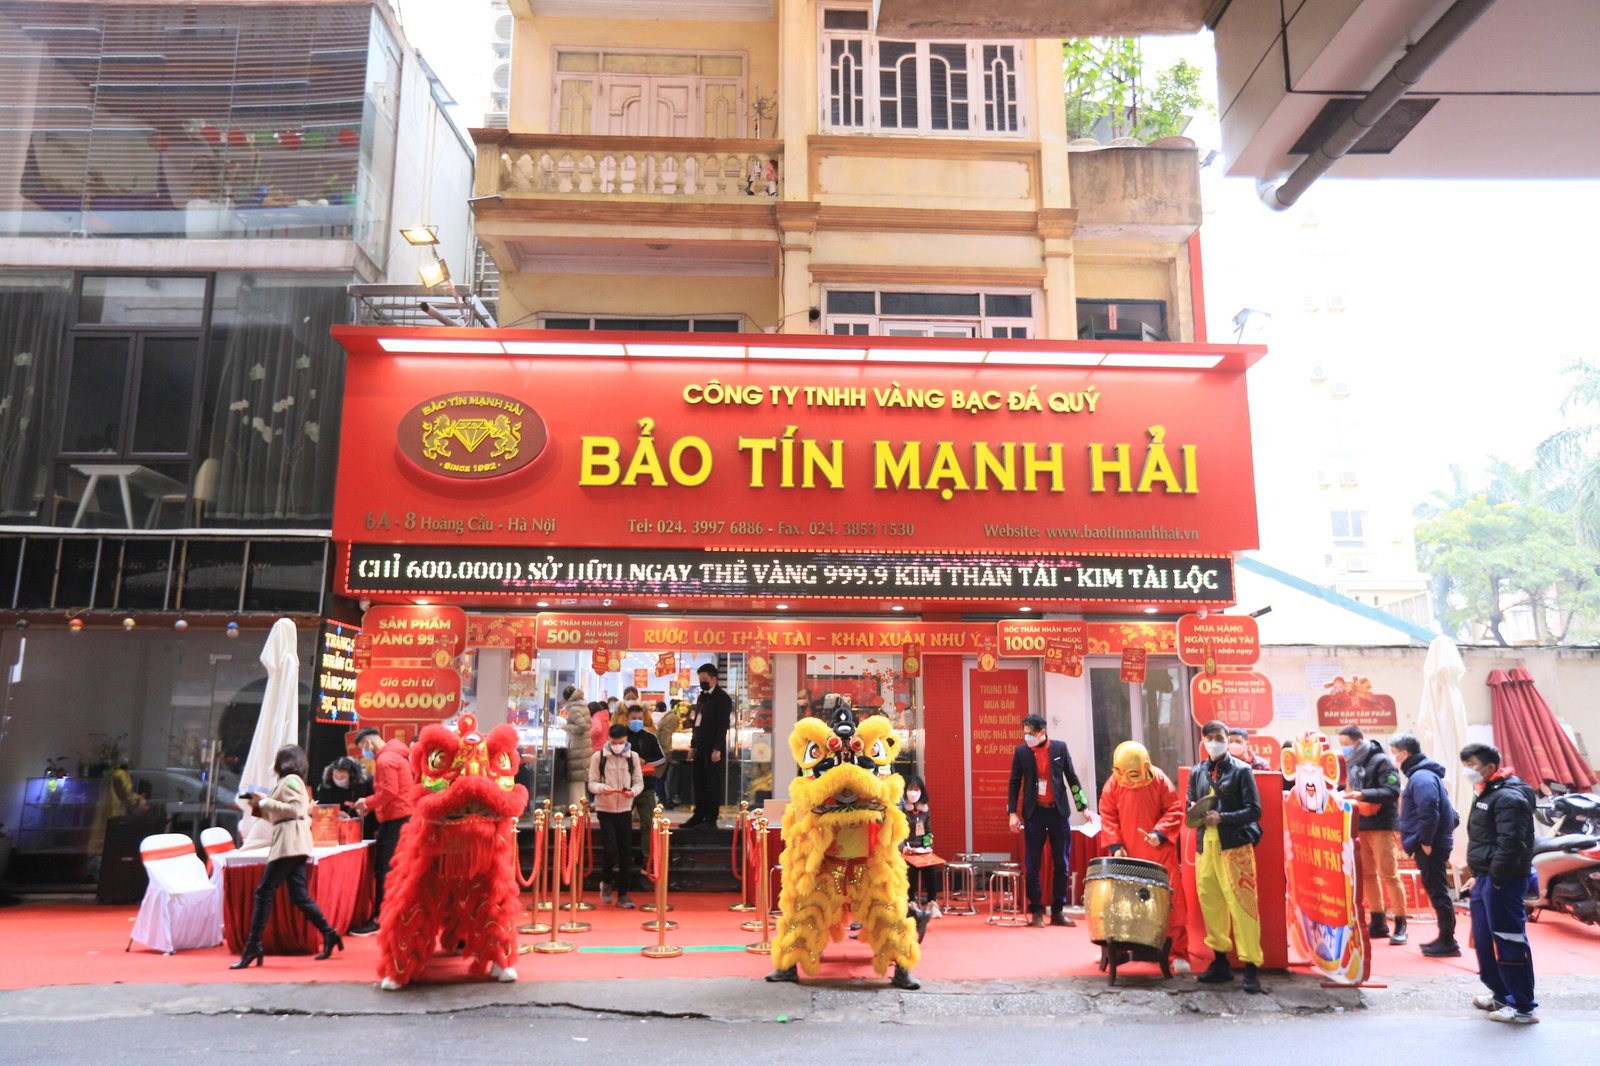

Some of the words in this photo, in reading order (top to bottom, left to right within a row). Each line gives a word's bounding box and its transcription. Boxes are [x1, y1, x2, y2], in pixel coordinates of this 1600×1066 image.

[683, 379, 764, 405] CÔNG
[769, 386, 799, 406] TY
[804, 386, 867, 407] TNHH
[873, 381, 946, 409] VÀNG
[951, 390, 1002, 414] BẠC
[1007, 385, 1043, 412] ĐÁ
[1048, 385, 1100, 413] QUÝ
[578, 417, 713, 487] BẢO
[738, 425, 845, 488] TÍN
[873, 440, 1065, 500] MẠNH
[1089, 425, 1199, 494] HẢI
[365, 511, 391, 531] 6A
[404, 512, 417, 530] 8
[420, 516, 465, 534] Hoàng
[467, 514, 494, 532] Cầu
[507, 517, 528, 532] Hà
[532, 518, 556, 534] Nội
[628, 518, 653, 533] Tel:
[657, 519, 687, 534] 024.
[692, 520, 726, 534] 3997
[730, 521, 764, 535] 6886
[808, 522, 838, 536] 024.
[844, 523, 877, 537] 3853
[882, 523, 915, 537] 1530
[984, 523, 1041, 539] Website:
[1046, 524, 1199, 541] www.baotinmanhhai.vn
[527, 555, 563, 580] SỞ
[629, 563, 693, 582] NGAY
[752, 559, 817, 584] VÀNG
[823, 565, 888, 585] 999.9
[895, 566, 942, 586] KIM
[1018, 563, 1057, 587] TÀI
[1077, 568, 1123, 588] KIM
[1128, 564, 1168, 590] TÀI
[1173, 564, 1218, 593] LỘC
[379, 615, 407, 629] SẢN
[410, 615, 451, 629] PHẨM
[1193, 625, 1215, 633] MUA
[1216, 623, 1243, 632] HÀNG
[371, 631, 414, 645] VÀNG
[546, 629, 580, 644] 500
[644, 627, 688, 645] RƯỚC
[693, 628, 725, 647] LỘC
[783, 629, 812, 646] TÀI
[831, 632, 874, 646] KHAI
[879, 630, 926, 647] XUÂN
[930, 632, 966, 647] NHƯ
[970, 631, 981, 647] Ý
[1004, 636, 1046, 651] 1000
[1184, 634, 1210, 645] NGÀY
[1239, 635, 1254, 644] TÀI
[1046, 648, 1063, 659] 05
[979, 685, 1002, 694] TRUNG
[1003, 683, 1019, 694] TÂM
[1198, 679, 1224, 695] 05
[984, 699, 1000, 709] MUA
[1000, 698, 1015, 709] BÁN
[979, 714, 998, 724] VÀNG
[999, 713, 1021, 724] MIẾNG
[973, 729, 991, 740] ĐƯỢC
[993, 729, 1007, 740] NHÀ
[1008, 728, 1024, 740] NƯỚ
[984, 743, 998, 754] CẤP
[1321, 825, 1342, 842] VÀNG
[1322, 847, 1342, 872] TÀI
